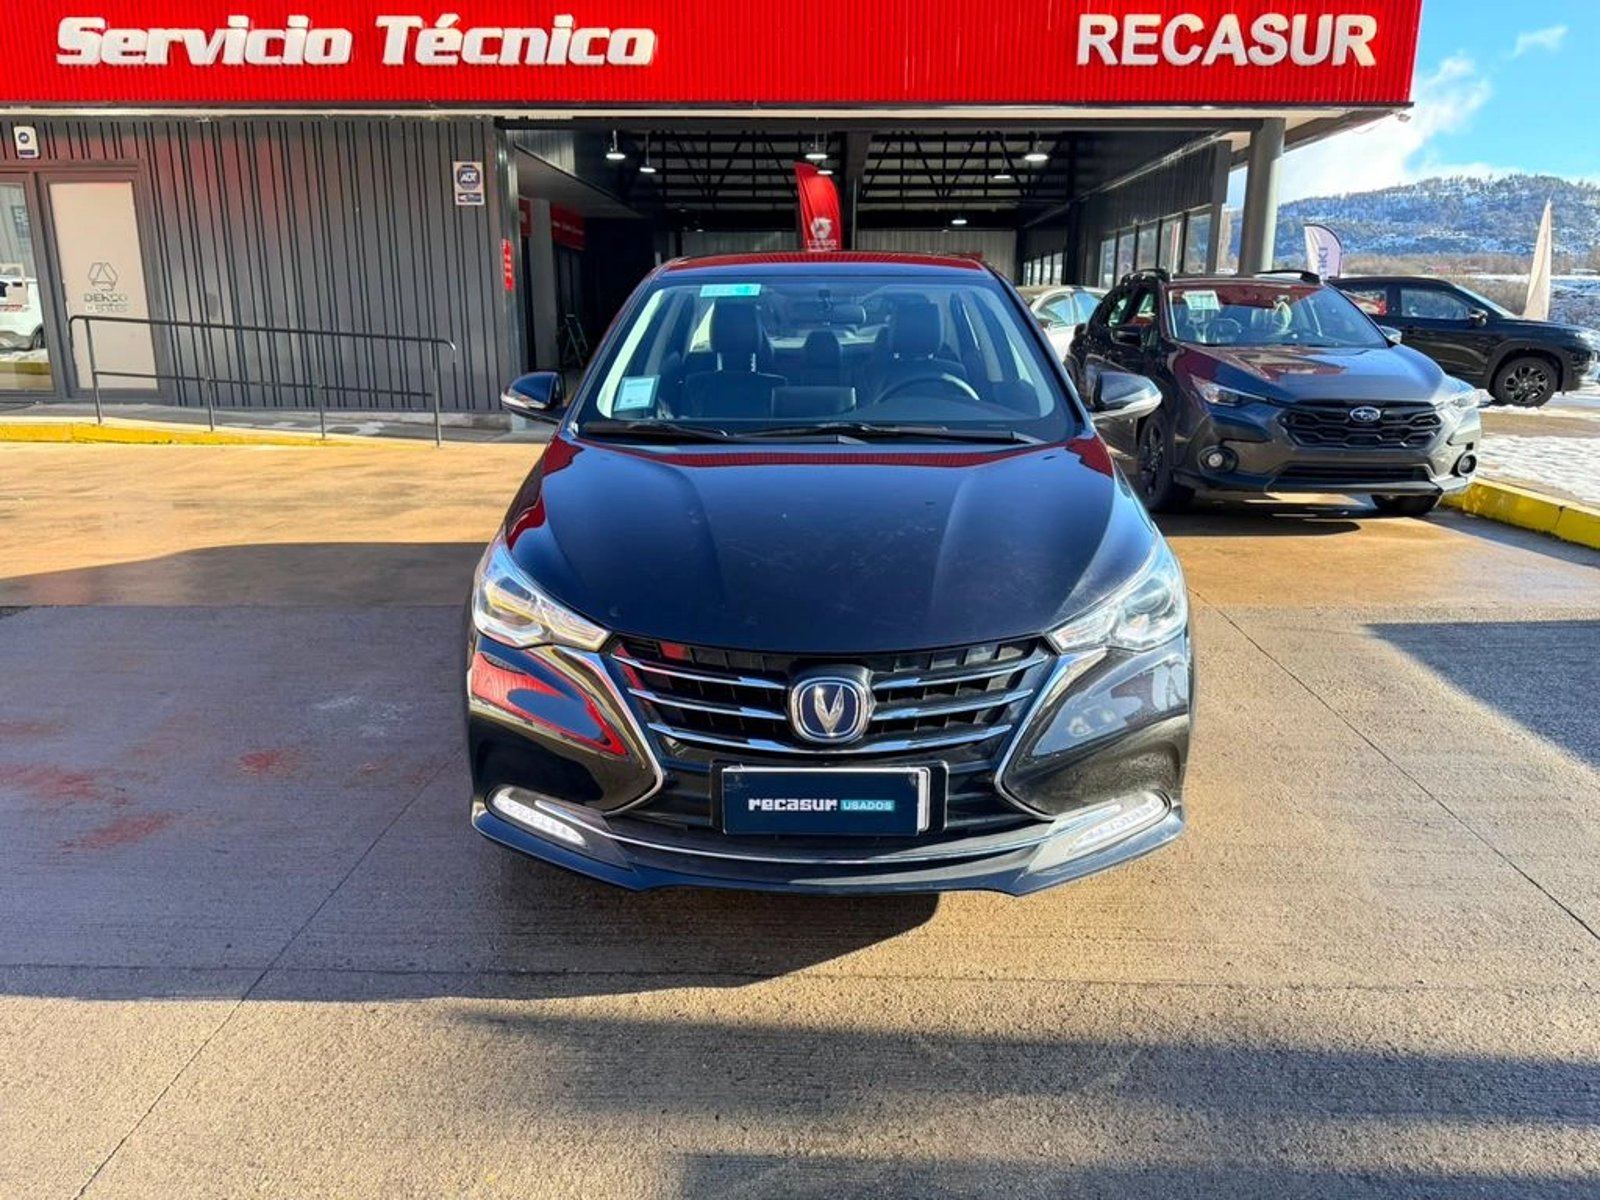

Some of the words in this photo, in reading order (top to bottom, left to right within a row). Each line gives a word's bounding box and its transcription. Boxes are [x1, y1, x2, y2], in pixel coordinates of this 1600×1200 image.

[56, 15, 353, 66] Servicio
[375, 13, 657, 66] Técnico
[1076, 13, 1378, 66] RECASUR
[843, 801, 892, 810] USADOS
